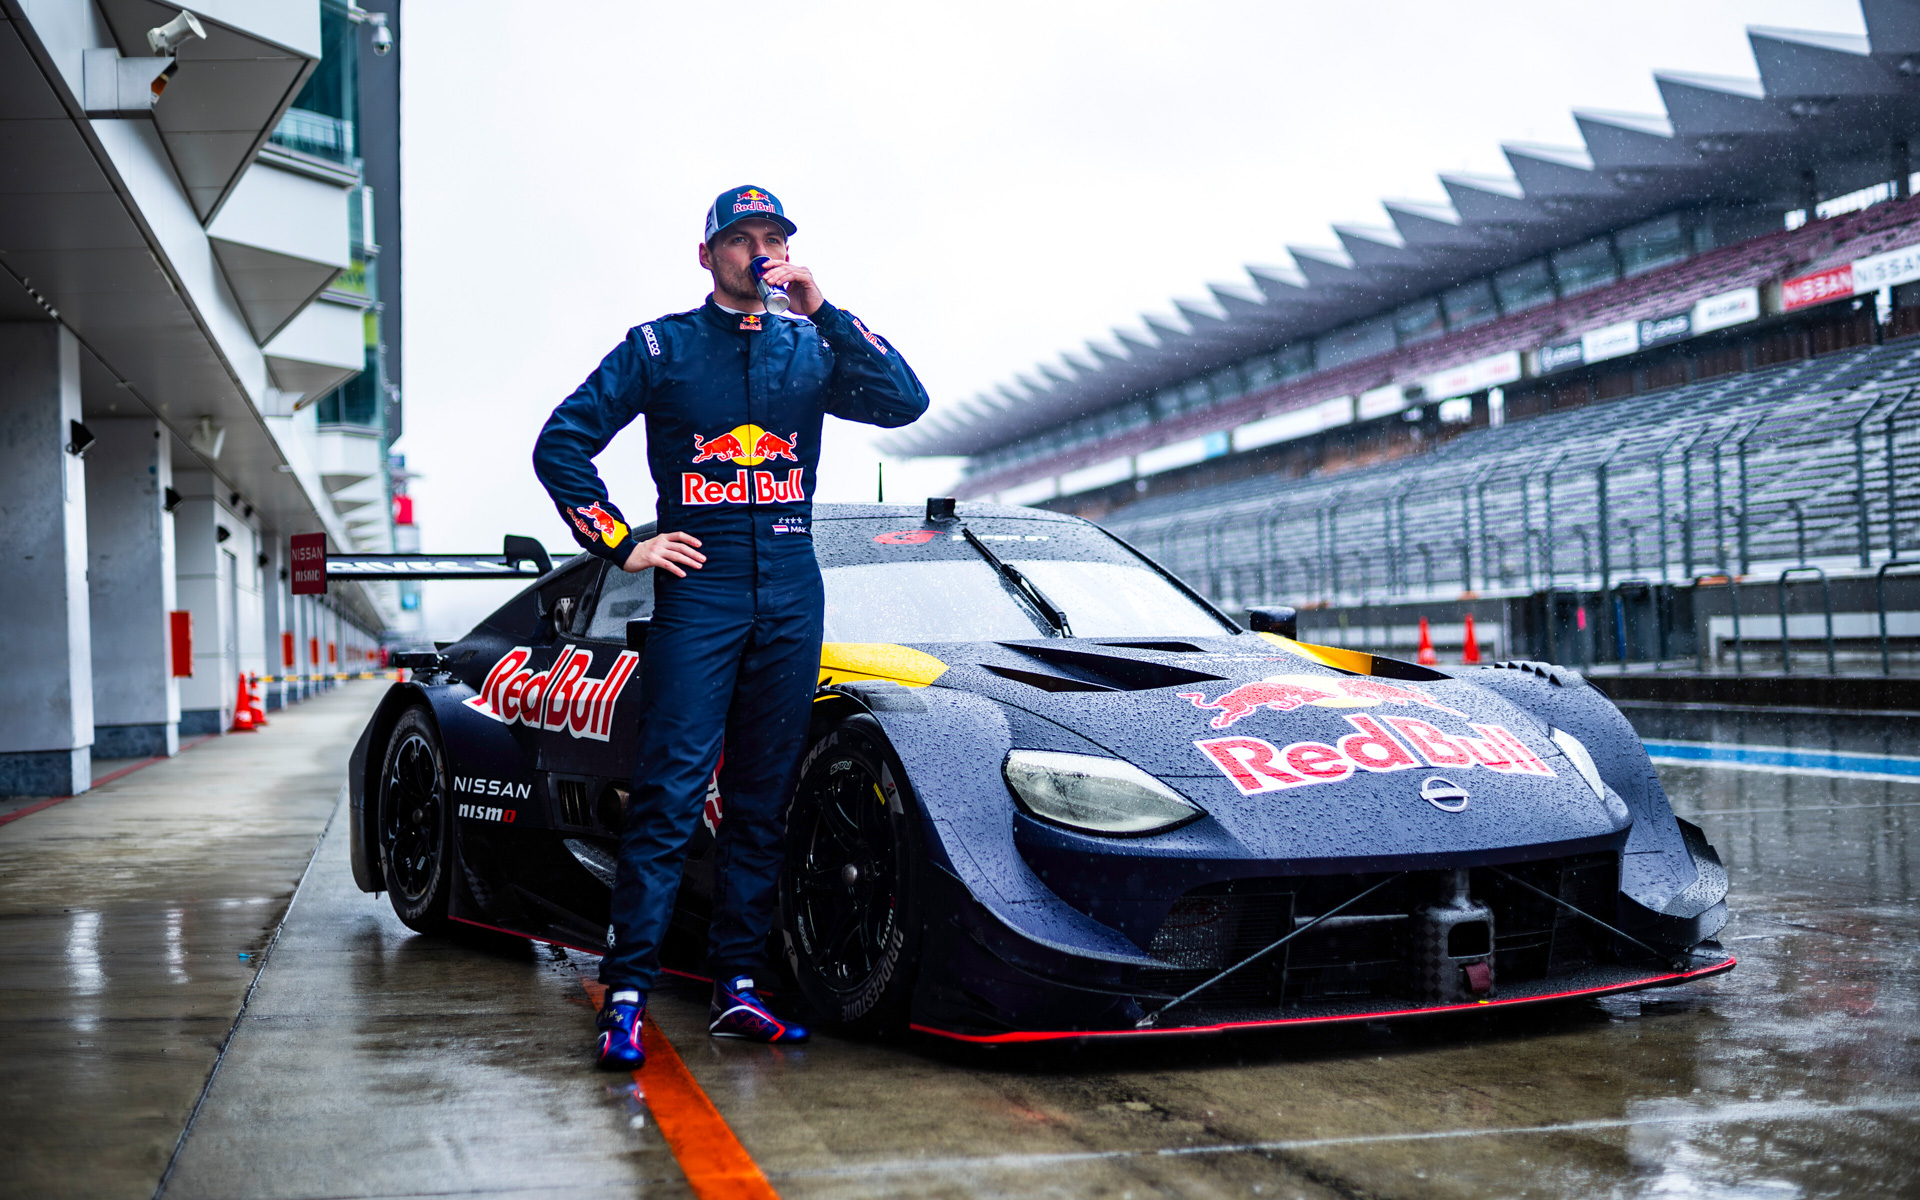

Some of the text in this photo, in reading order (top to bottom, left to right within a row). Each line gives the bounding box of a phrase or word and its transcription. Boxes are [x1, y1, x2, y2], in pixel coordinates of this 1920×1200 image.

[733, 201, 776, 214] Red Bull
[1784, 271, 1853, 306] NISSAN
[643, 324, 661, 356] sparco
[682, 467, 805, 505] Red Bull
[579, 522, 600, 542] Bull
[952, 534, 1021, 542] SPER
[291, 546, 323, 561] NISSAN
[462, 644, 640, 742] Red Bull
[1193, 713, 1559, 796] Red Bull
[454, 776, 532, 799] NISSAN
[458, 803, 516, 823] nismo
